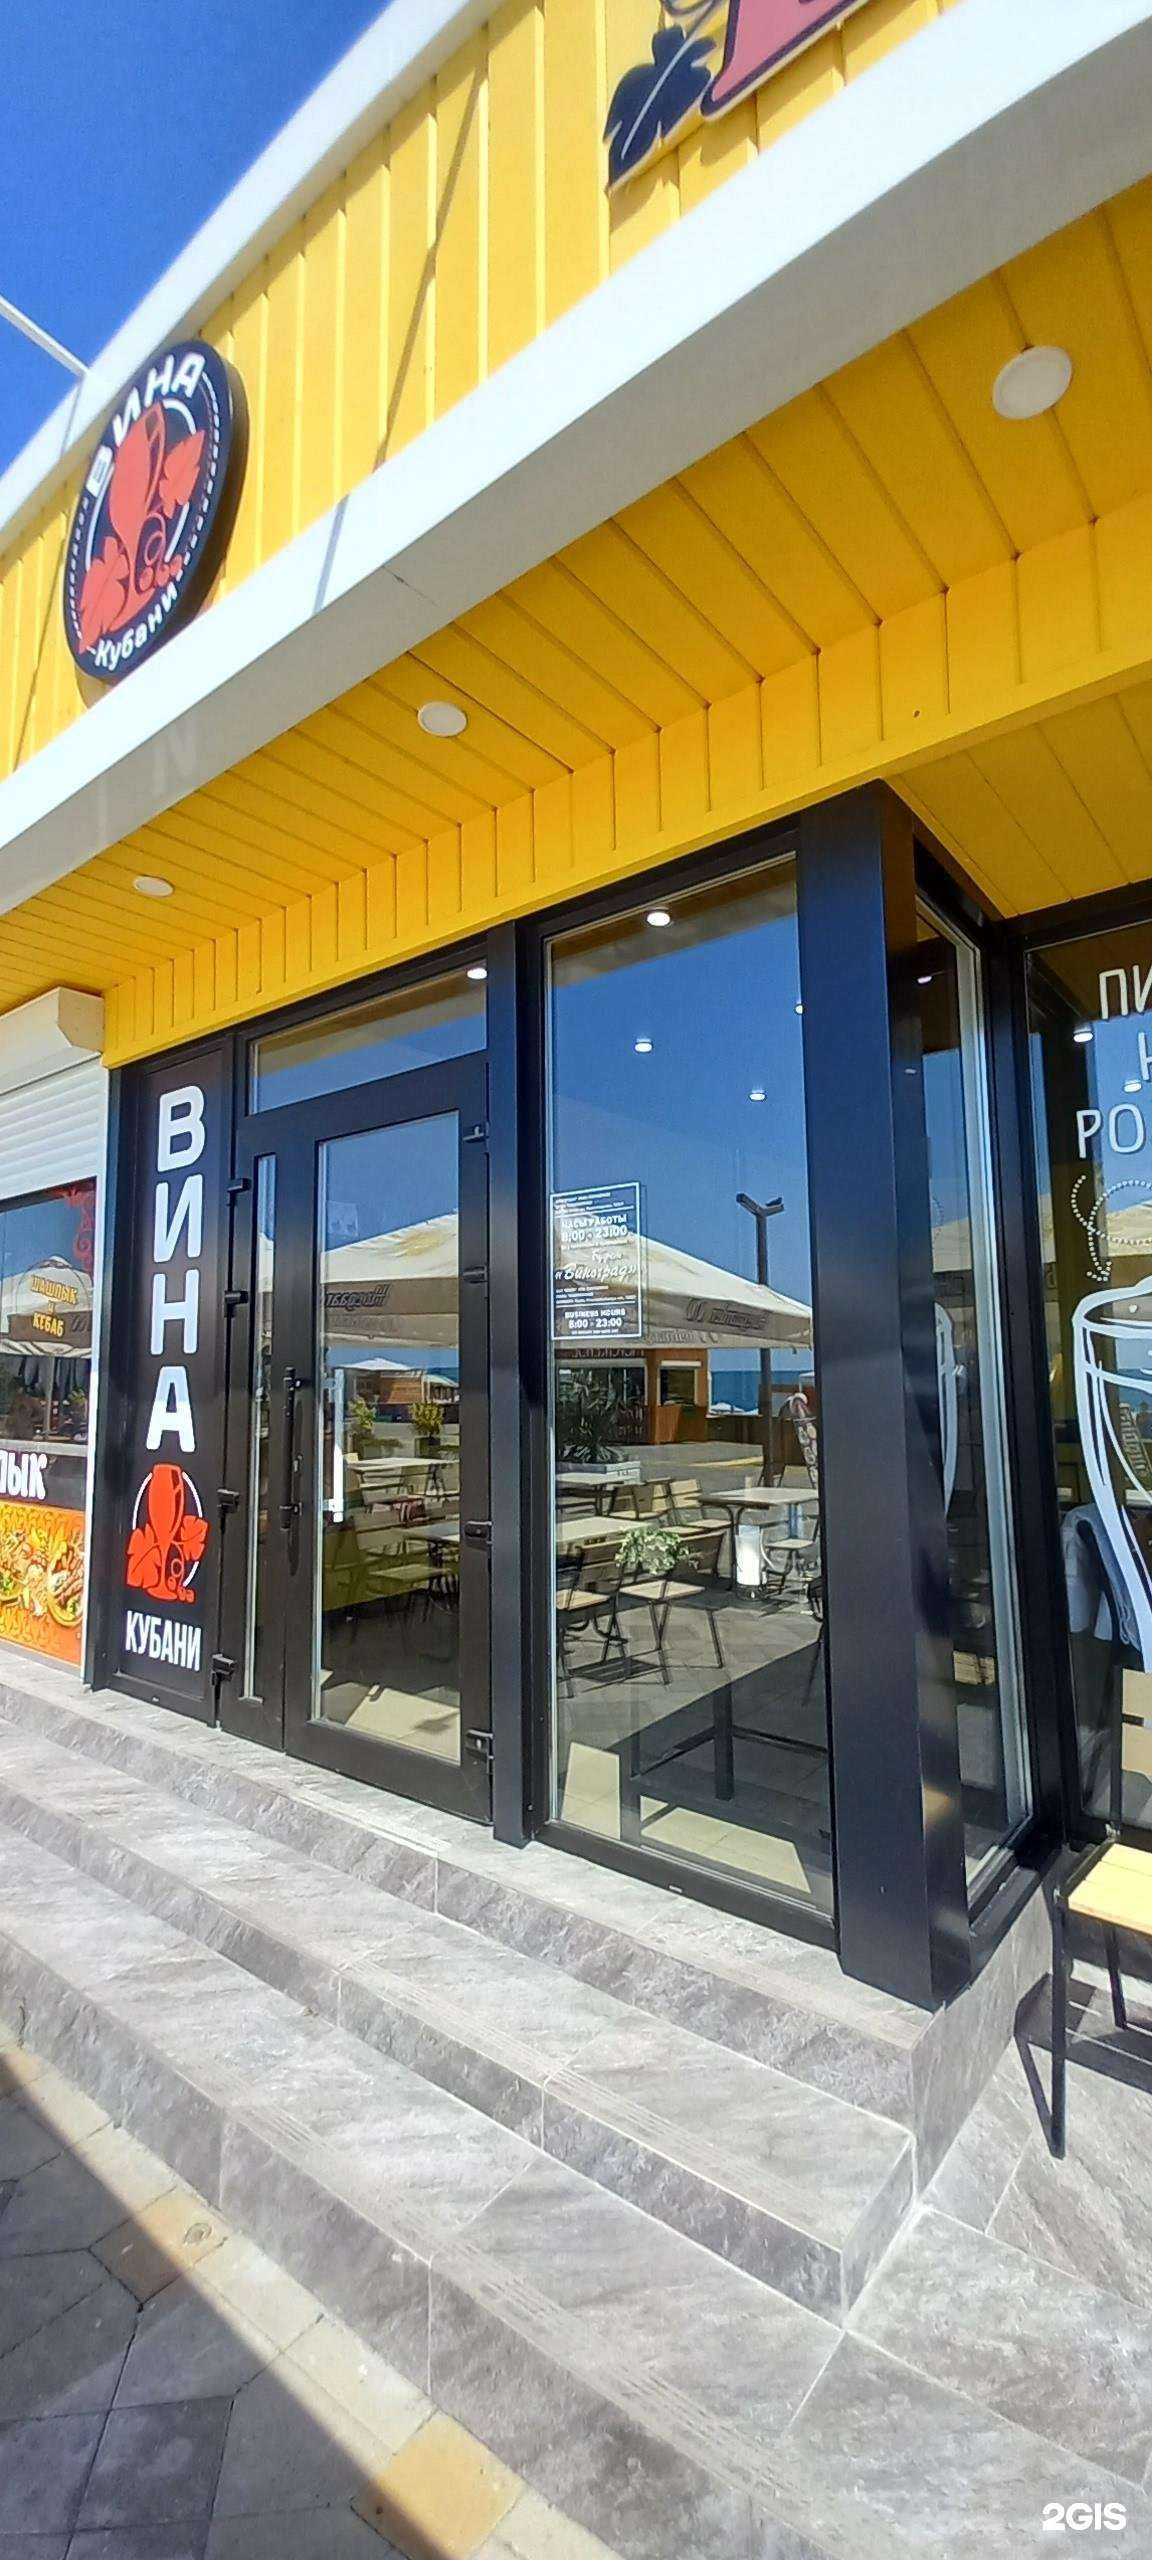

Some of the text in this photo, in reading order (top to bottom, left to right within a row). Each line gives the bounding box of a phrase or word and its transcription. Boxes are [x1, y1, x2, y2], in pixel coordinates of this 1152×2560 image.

[88, 352, 206, 498] ВИНА
[94, 586, 178, 671] Кубани
[1076, 1103, 1144, 1159] РО
[146, 1084, 206, 1454] ВИНА
[33, 1312, 64, 1337] КЕБАБ
[125, 1610, 201, 1671] КУБАНИ
